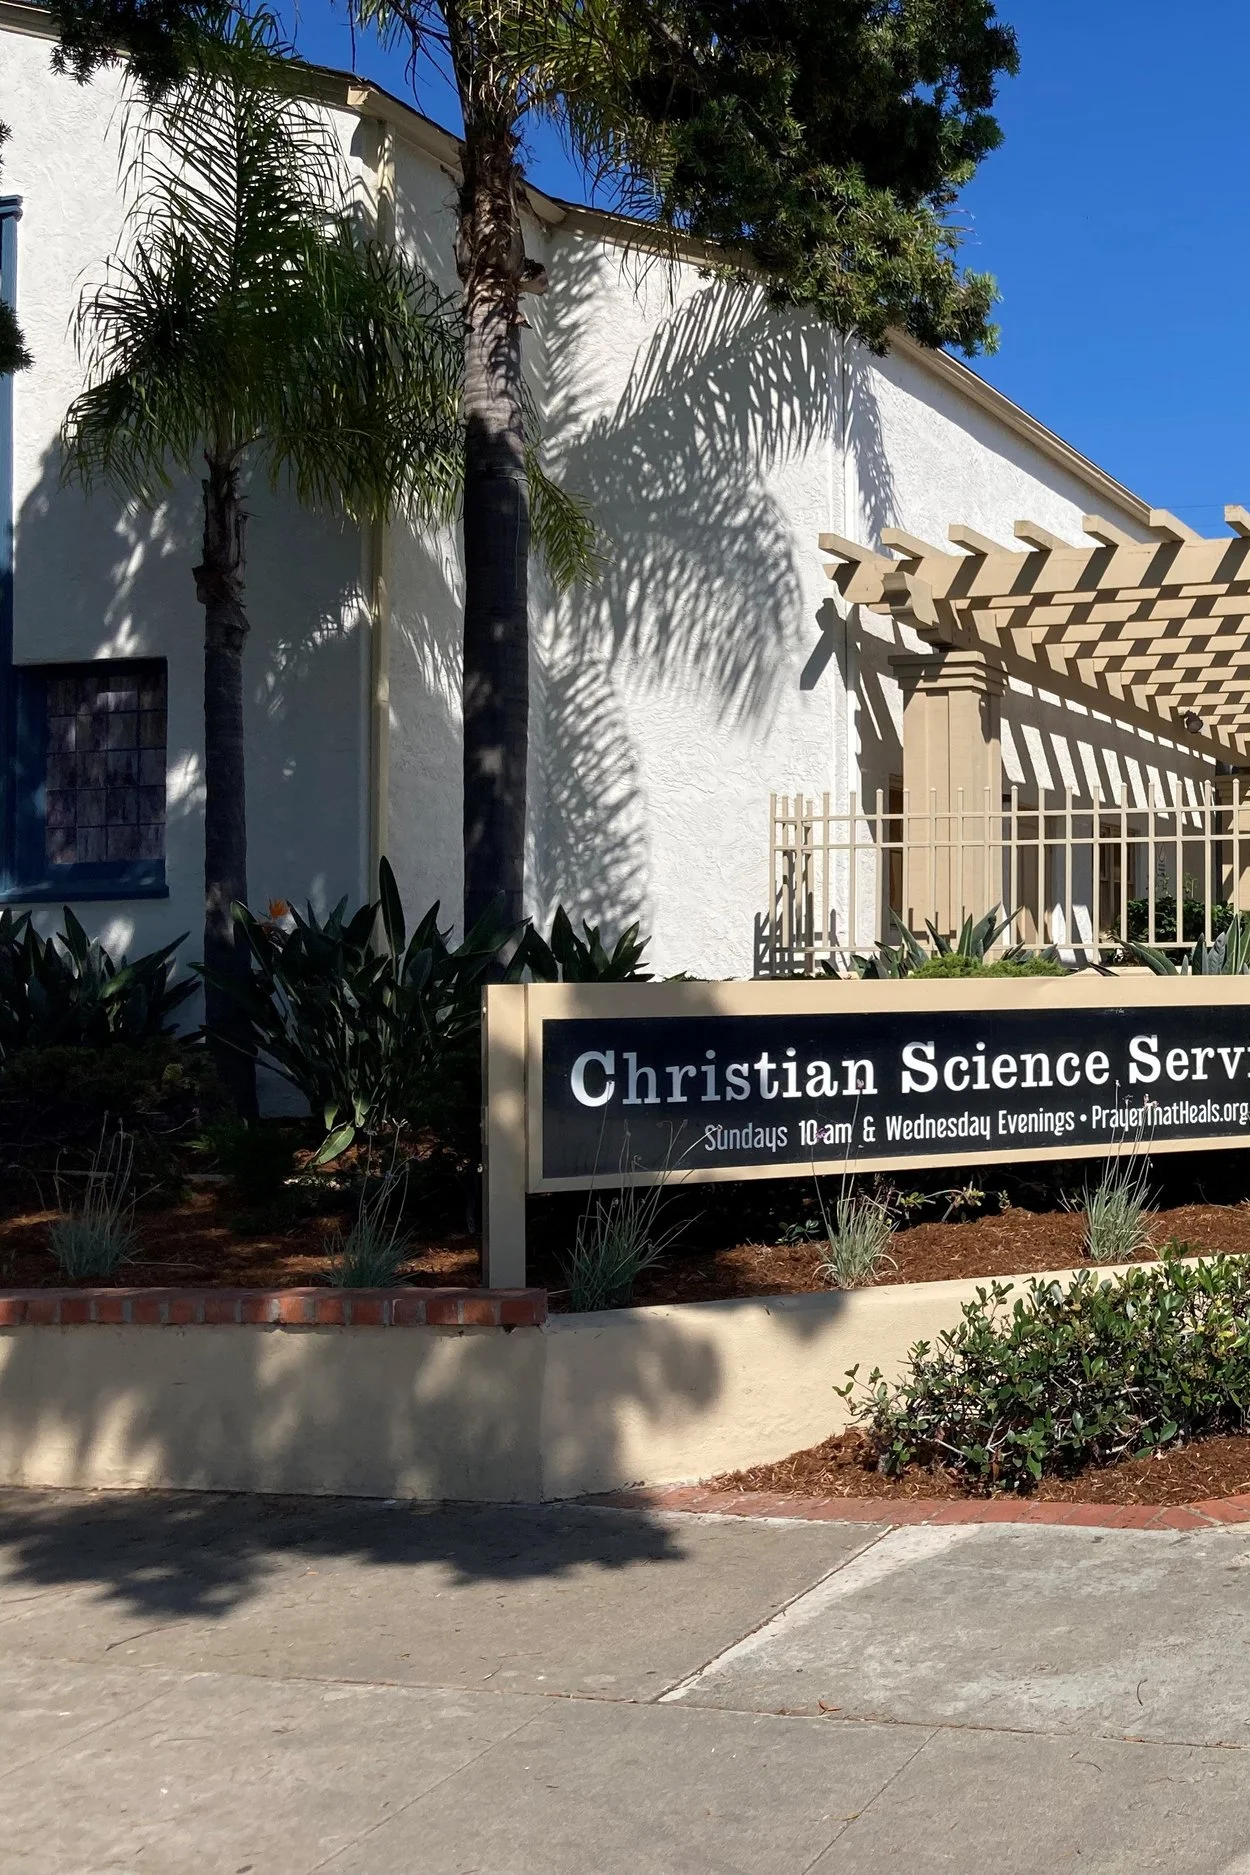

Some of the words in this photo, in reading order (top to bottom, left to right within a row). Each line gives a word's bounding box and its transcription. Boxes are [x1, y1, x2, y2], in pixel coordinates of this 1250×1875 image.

[570, 1046, 879, 1108] Christian
[901, 1040, 1111, 1093] Science
[703, 1122, 788, 1153] Sundays
[862, 1115, 876, 1142] &
[885, 1112, 991, 1141] Wednesday
[998, 1106, 1076, 1136] Evenings
[1091, 1098, 1249, 1132] PrayerThatHeals.org
